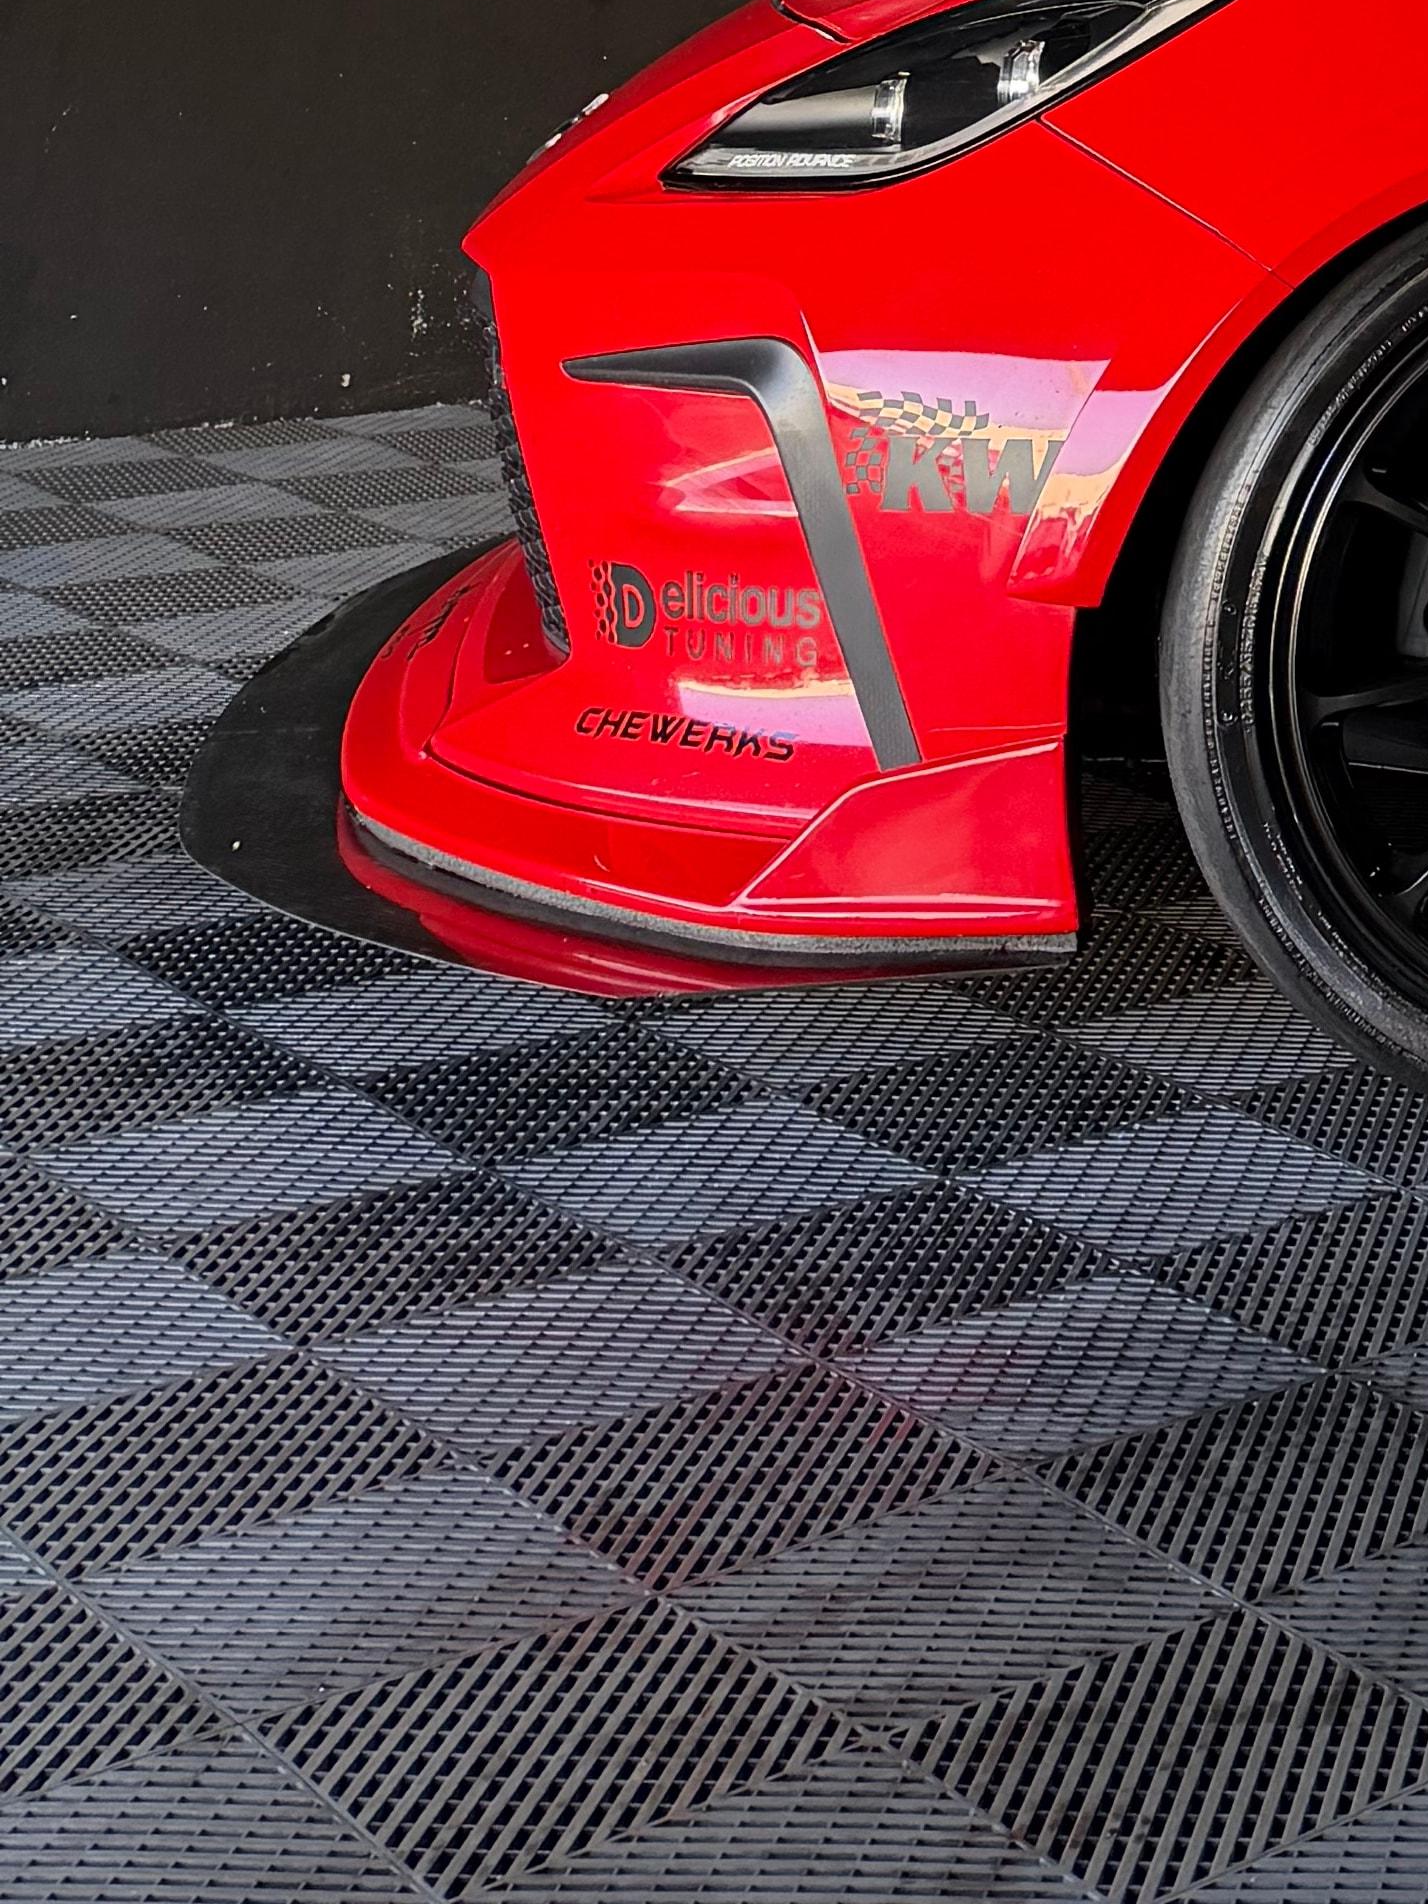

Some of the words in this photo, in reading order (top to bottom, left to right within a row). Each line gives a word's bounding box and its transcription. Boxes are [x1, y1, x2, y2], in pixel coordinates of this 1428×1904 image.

[728, 153, 785, 168] POSITION
[878, 436, 1067, 513] KW
[664, 625, 819, 667] TUNING
[575, 708, 799, 762] CHEWERKS
